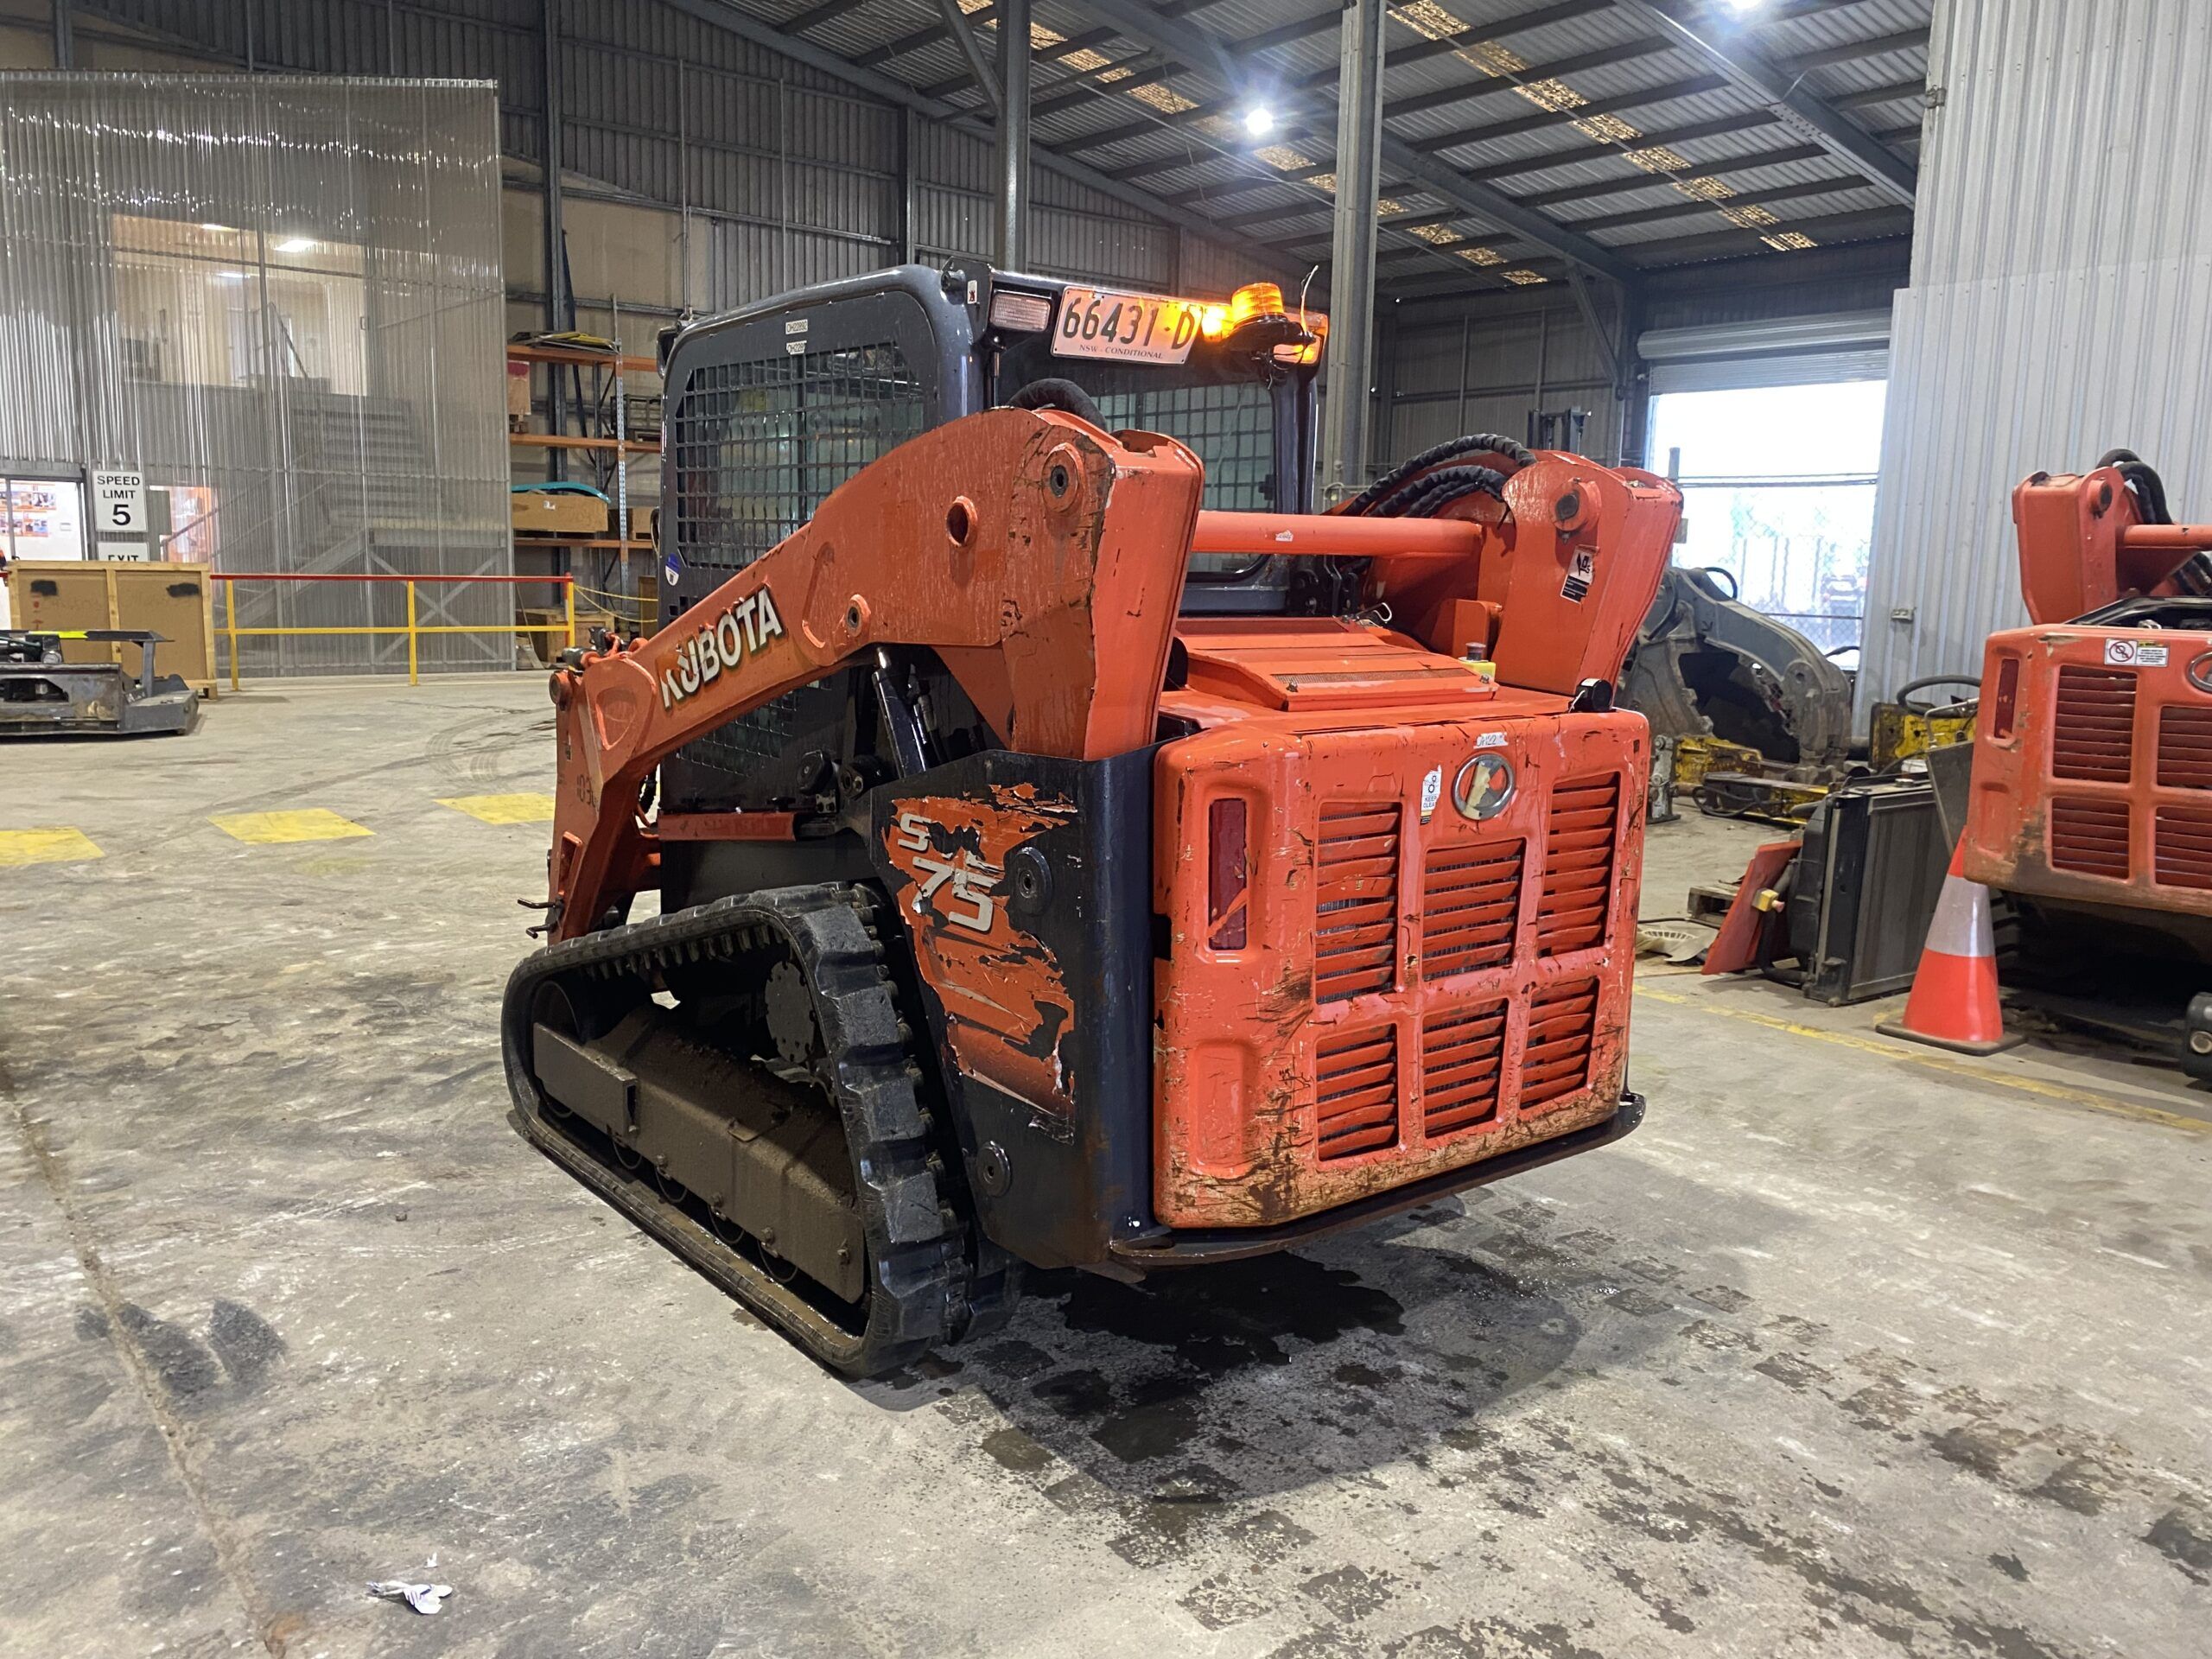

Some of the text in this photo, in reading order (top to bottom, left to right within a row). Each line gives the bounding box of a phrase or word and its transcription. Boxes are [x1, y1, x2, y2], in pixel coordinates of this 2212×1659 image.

[1063, 297, 1196, 350] 66431 D
[1080, 344, 1097, 353] NSW
[1104, 346, 1163, 359] CONDITIONAL
[97, 475, 140, 486] SPEED
[103, 489, 136, 499] LIMIT
[111, 504, 131, 526] 5
[912, 856, 1003, 932] 75
